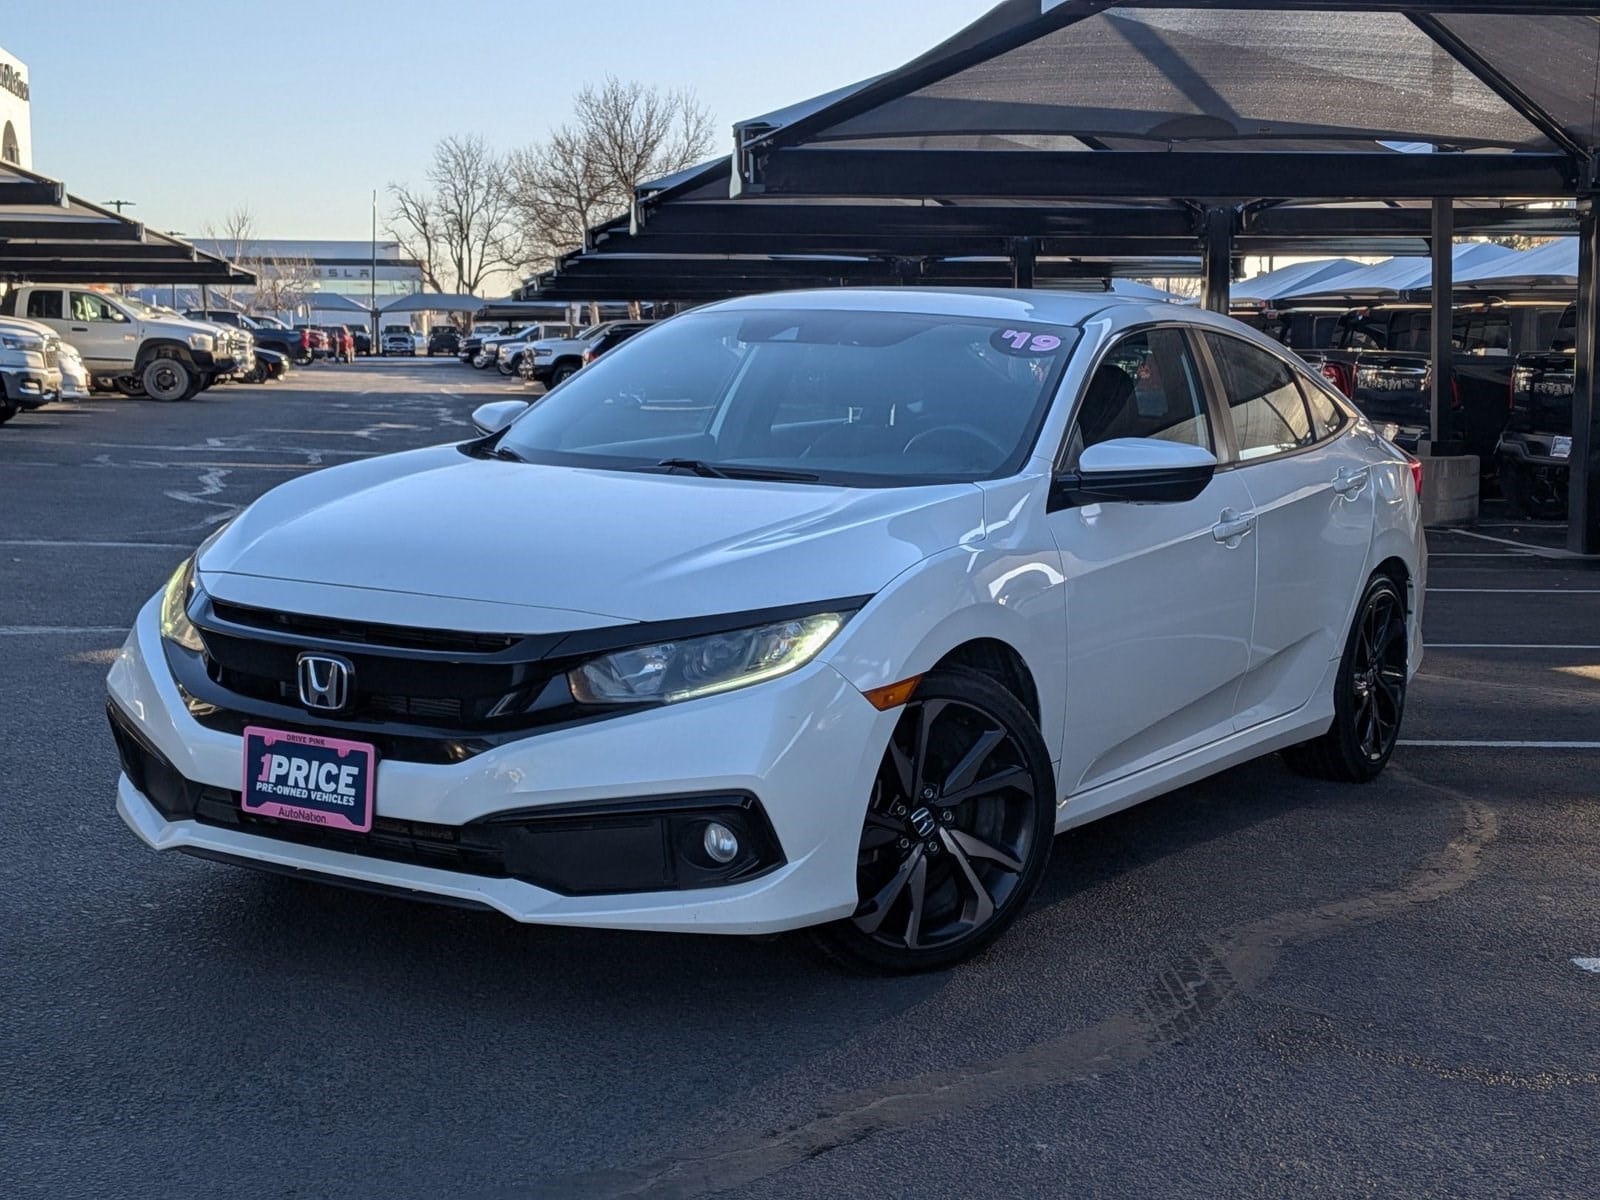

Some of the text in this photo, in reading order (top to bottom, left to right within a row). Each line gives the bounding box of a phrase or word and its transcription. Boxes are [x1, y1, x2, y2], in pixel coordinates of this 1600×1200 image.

[1001, 329, 1061, 352] '19
[286, 734, 326, 746] DRIVE PINK
[256, 781, 355, 806] PRE-OWNED VEHICLES
[278, 807, 327, 824] AutoNation
